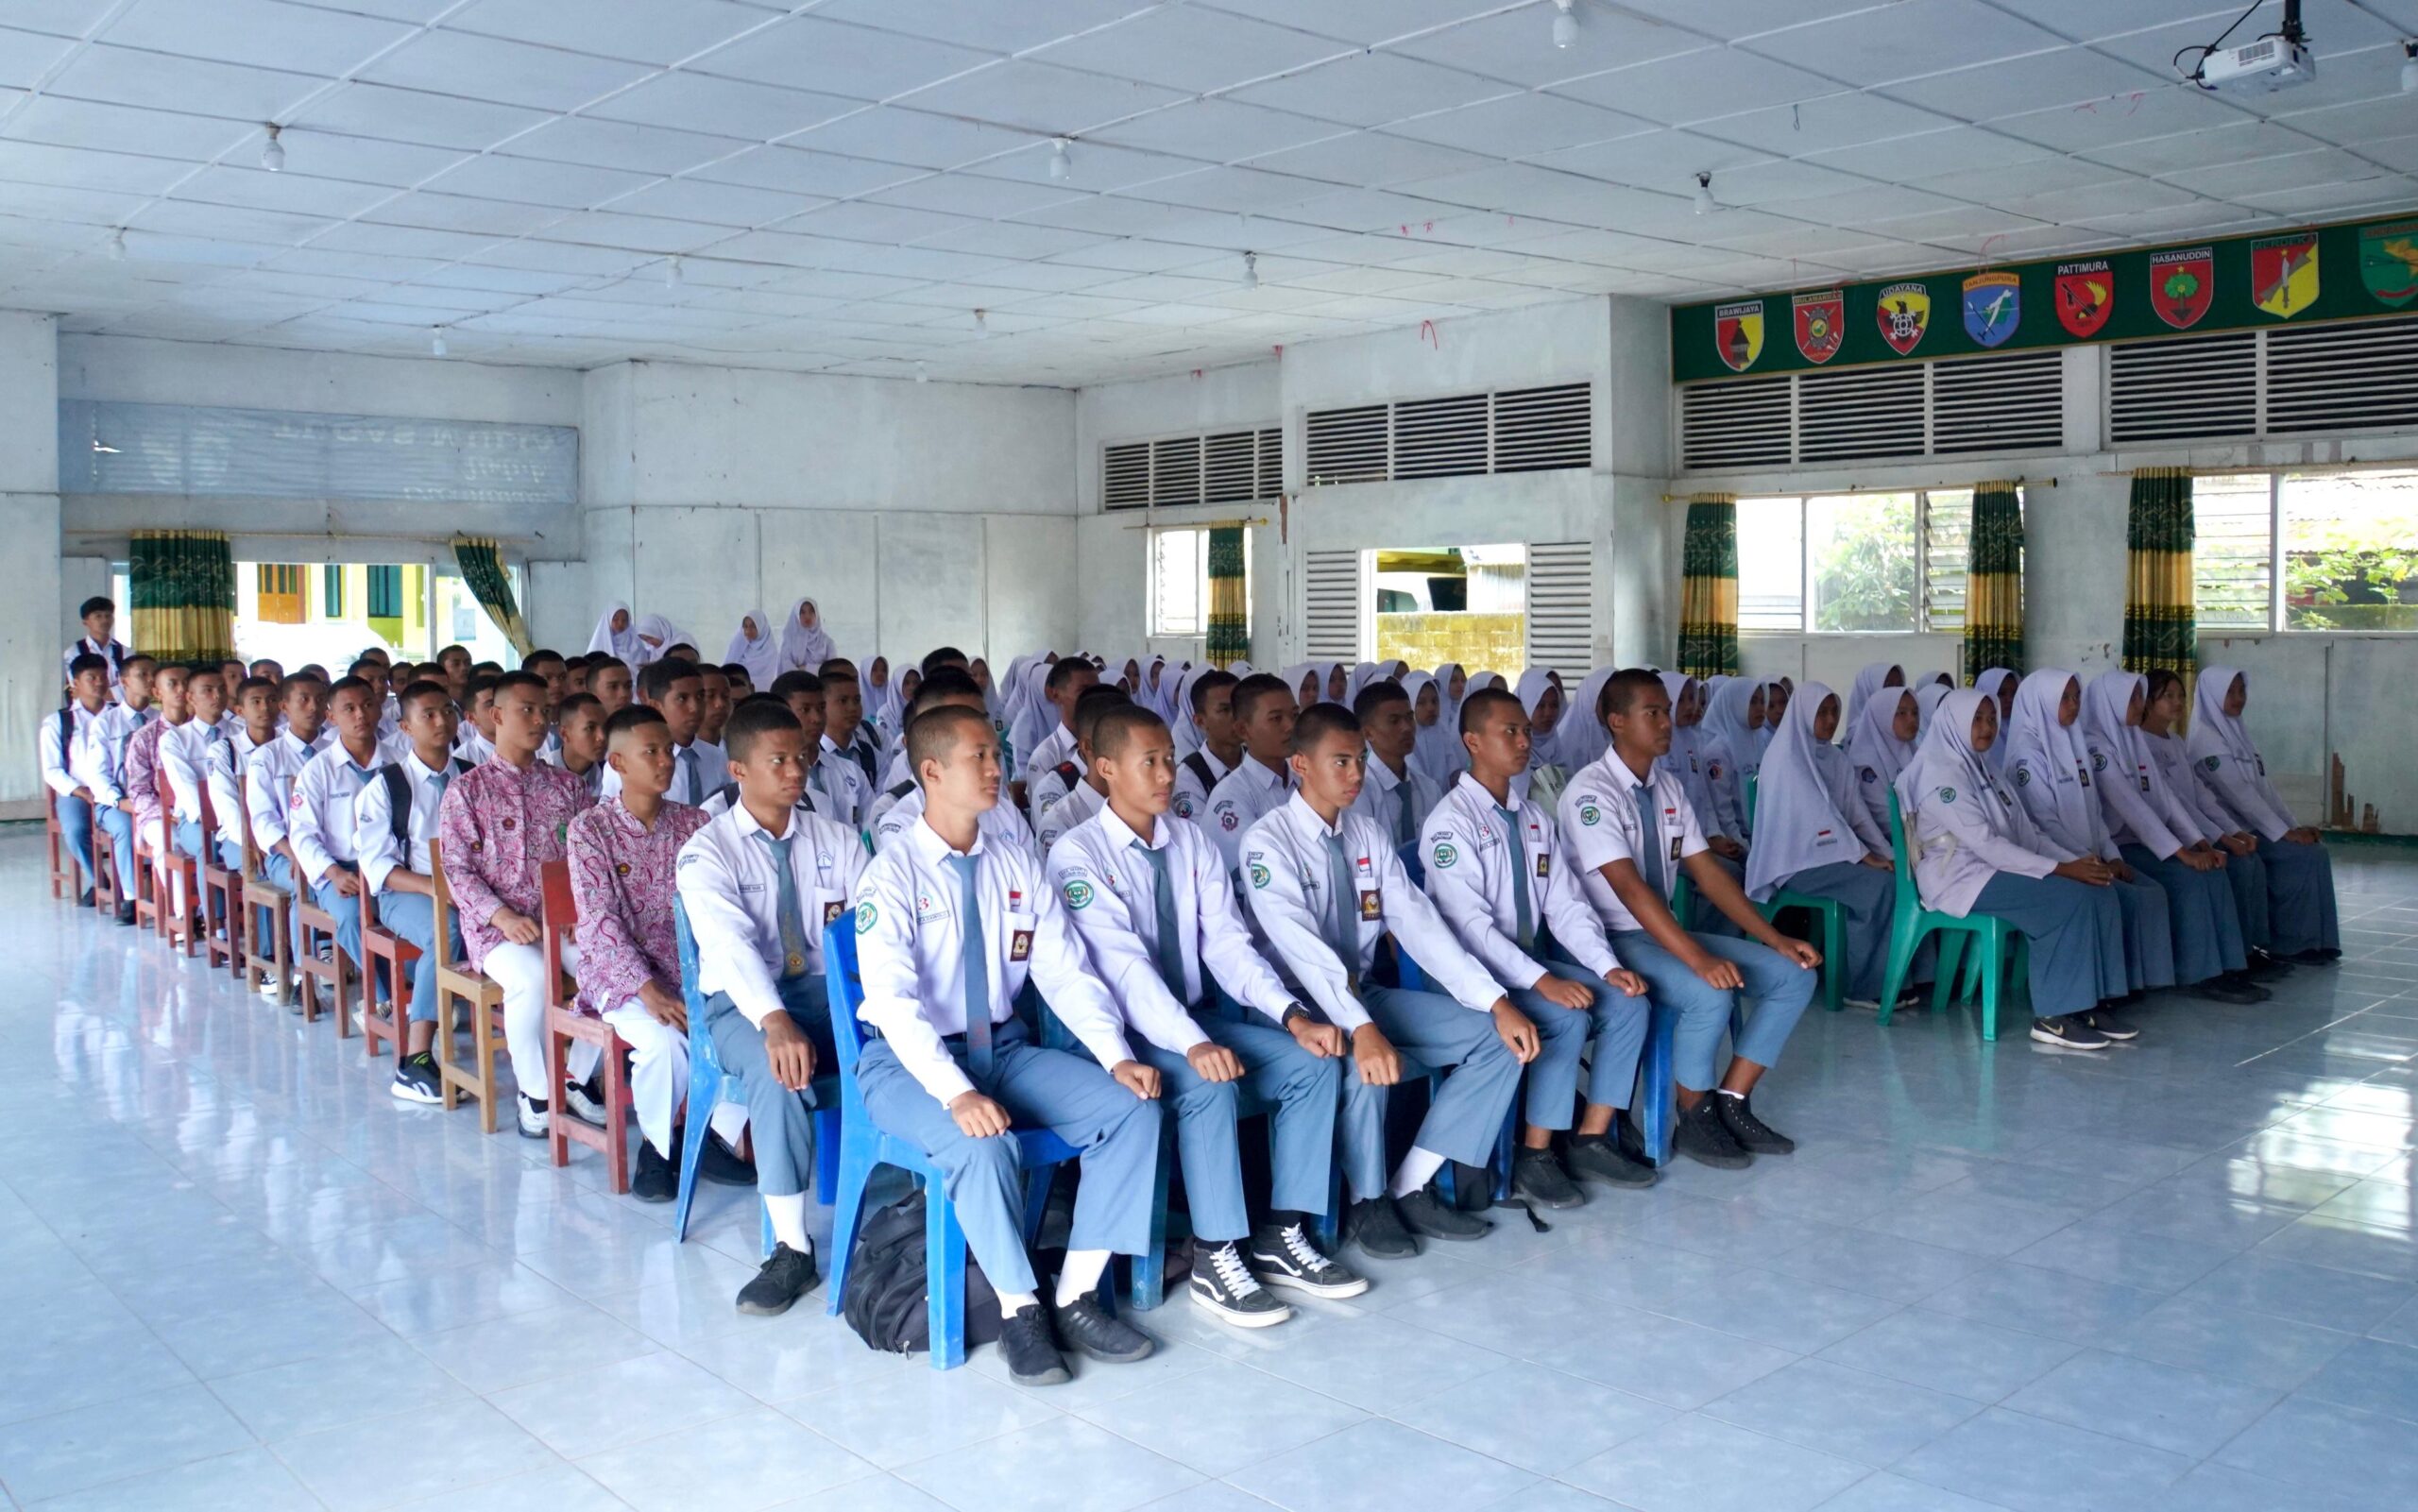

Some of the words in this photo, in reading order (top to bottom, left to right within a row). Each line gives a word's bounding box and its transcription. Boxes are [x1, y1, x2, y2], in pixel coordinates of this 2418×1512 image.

[2152, 250, 2210, 264] HASANUDDIN
[2057, 261, 2108, 275] PATTIMURA
[1882, 284, 1923, 297] UDAYANA
[1719, 305, 1760, 316] BRAWIJAYA
